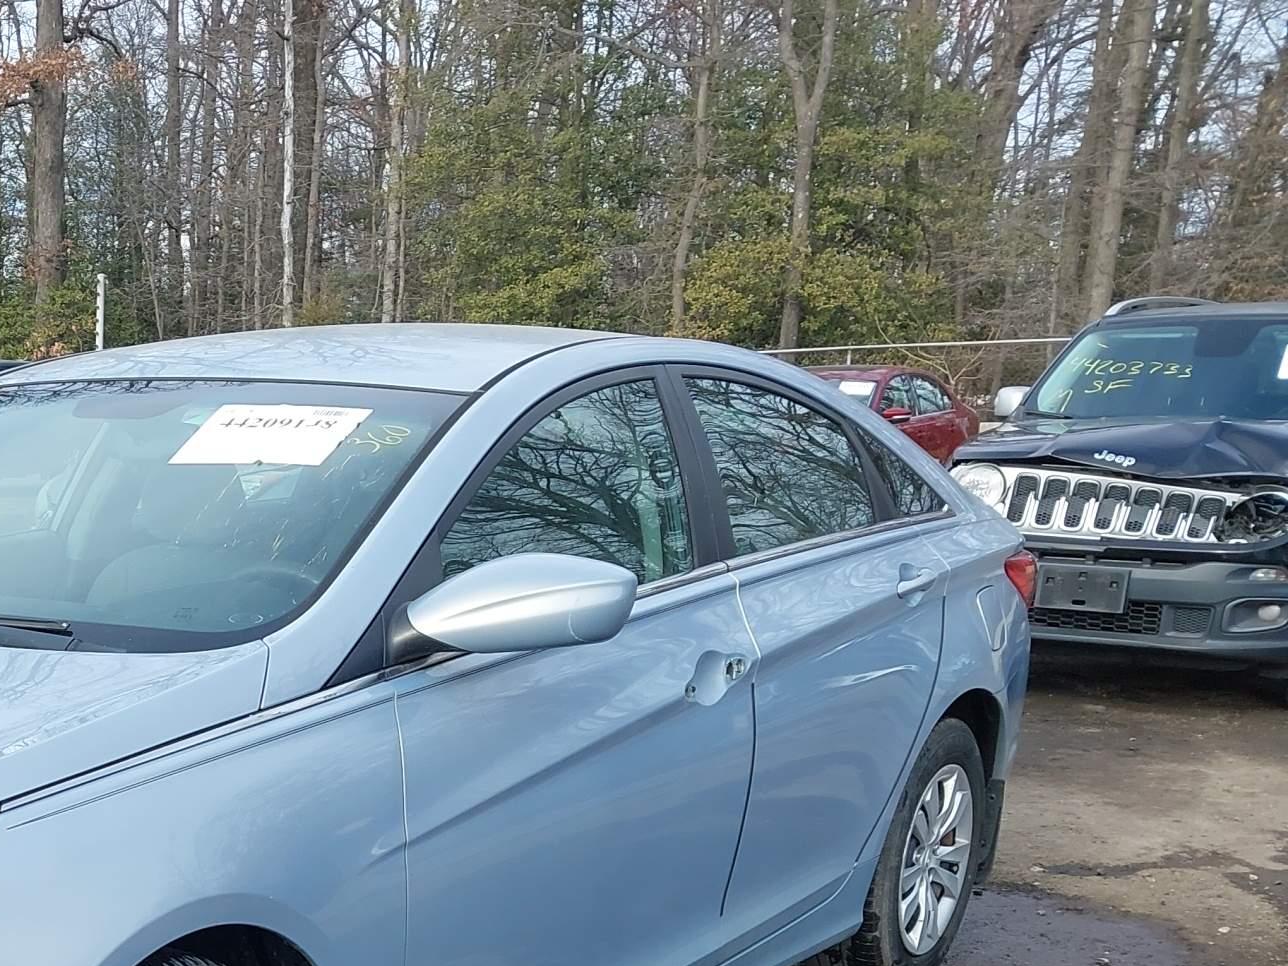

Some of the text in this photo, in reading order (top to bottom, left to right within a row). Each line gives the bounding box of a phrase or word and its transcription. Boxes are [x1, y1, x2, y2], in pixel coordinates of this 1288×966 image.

[219, 417, 338, 430] 44209148
[347, 425, 411, 454] 360
[1094, 450, 1136, 467] Jeep
